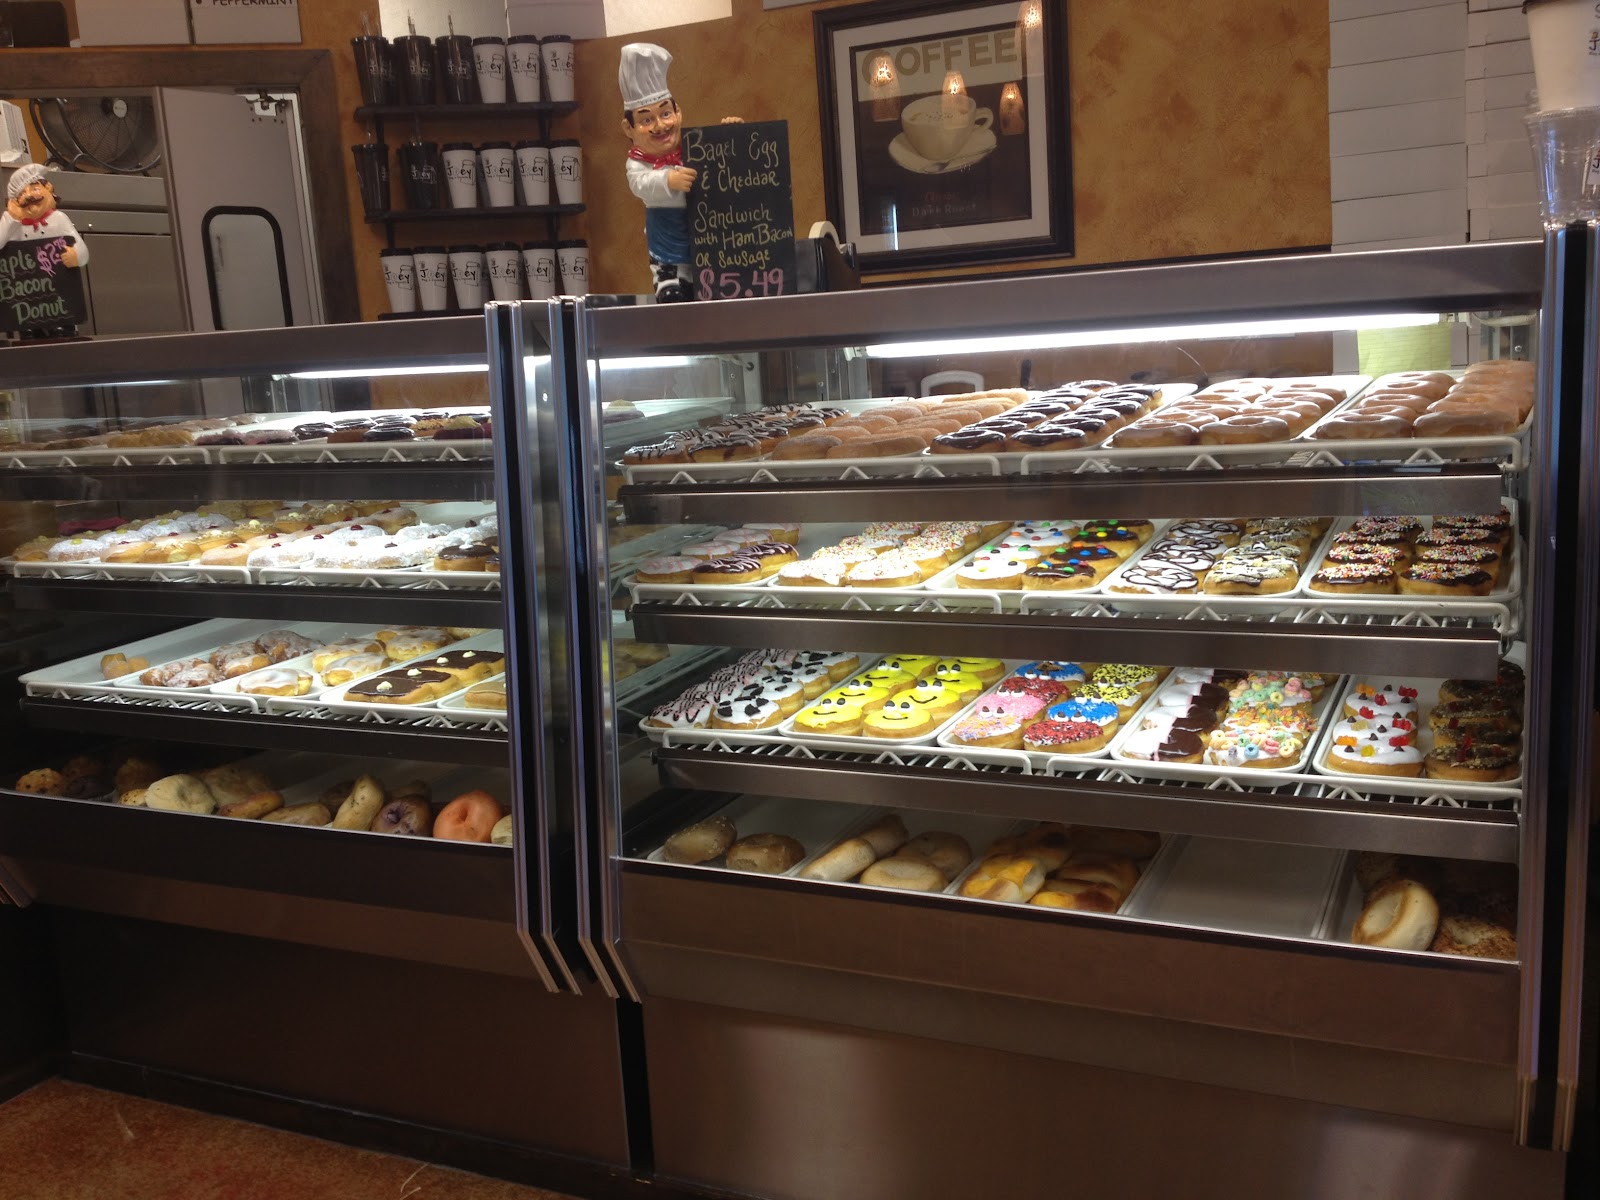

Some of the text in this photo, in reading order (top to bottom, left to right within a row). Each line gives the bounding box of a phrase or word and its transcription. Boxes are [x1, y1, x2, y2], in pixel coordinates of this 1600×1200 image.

[861, 30, 1018, 87] COFFEE
[683, 127, 779, 169] Bagel Egg
[694, 201, 774, 233] Sandwich
[694, 231, 719, 246] with
[0, 249, 37, 280] aple
[0, 278, 56, 302] Bacon
[697, 267, 784, 300] $5.49
[12, 296, 68, 325] Donut
